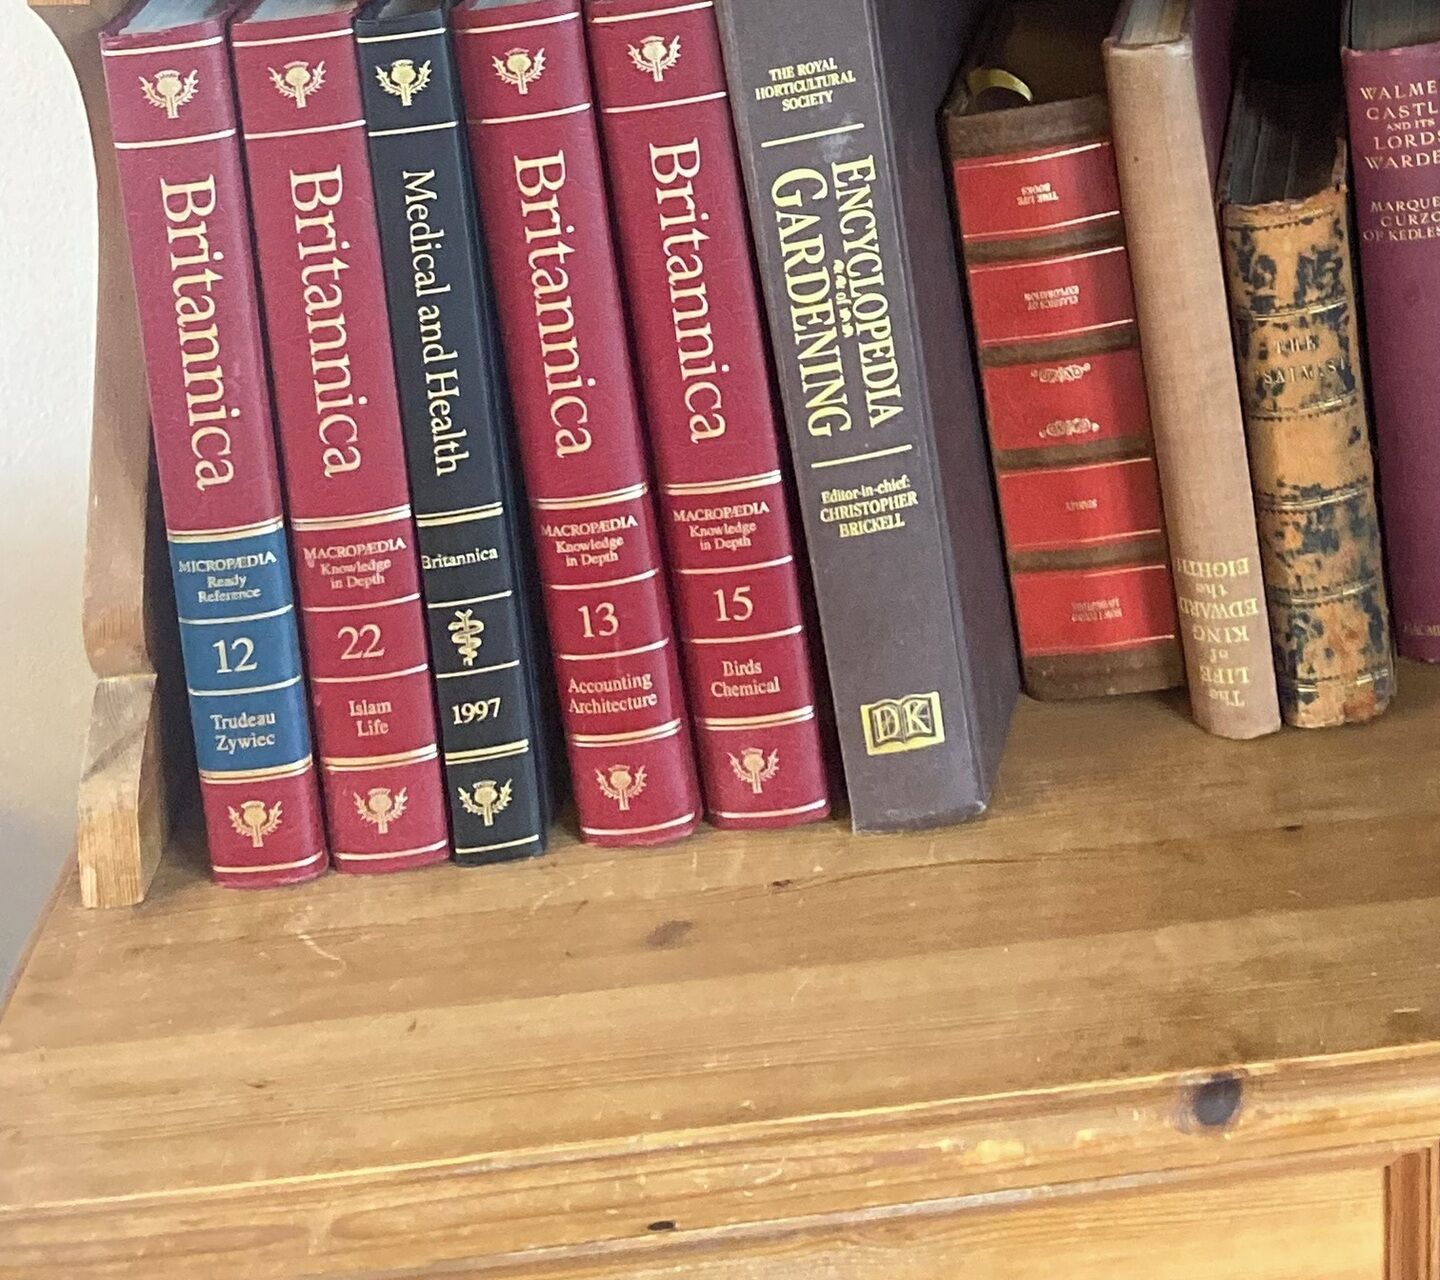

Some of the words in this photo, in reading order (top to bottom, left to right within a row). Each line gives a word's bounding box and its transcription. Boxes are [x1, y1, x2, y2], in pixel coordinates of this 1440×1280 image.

[768, 66, 795, 81] THE
[797, 57, 837, 76] ROYAL
[755, 70, 856, 100] HORTICULTURAL
[782, 90, 833, 111] SOCIETY
[1386, 121, 1411, 132] AND
[1415, 118, 1435, 129] ITS
[402, 170, 451, 298] Medical
[649, 138, 730, 444] Britannica
[831, 155, 903, 428] ENCYCLOPEDIA
[836, 291, 852, 305] of
[514, 150, 596, 458] Britannica
[771, 167, 851, 438] GARDENING
[289, 164, 367, 478] Britannica
[160, 174, 240, 492] Britannica
[418, 307, 458, 365] and
[424, 371, 470, 477] Health
[820, 491, 918, 522] CHRISTOPHER
[689, 520, 757, 538] Knowledge
[839, 513, 905, 538] BRICKELL
[556, 534, 624, 554] Knowledge
[700, 541, 711, 551] in
[715, 535, 751, 551] Depth
[320, 557, 391, 577] Knowledge
[421, 546, 499, 570] Britannica
[566, 556, 577, 567] in
[581, 551, 618, 567] Depth
[207, 573, 246, 591] Ready
[331, 577, 343, 589] in
[347, 573, 385, 590] Depth
[1195, 583, 1229, 599] the
[198, 587, 261, 603] Reference
[714, 585, 753, 622] 15
[1179, 597, 1259, 619] EDWARD
[578, 602, 619, 638] 13
[338, 624, 385, 660] 22
[1193, 625, 1250, 644] KING
[212, 637, 258, 674] 12
[1210, 649, 1228, 663] of
[722, 659, 762, 677] Birds
[1201, 666, 1250, 684] LIFE
[568, 673, 652, 695] Accounting
[711, 677, 780, 698] Chemical
[349, 698, 392, 717] Islam
[568, 693, 657, 715] Architecture
[1210, 690, 1246, 708] The
[210, 711, 275, 732] Trudeau
[452, 697, 501, 725] 1997
[357, 719, 389, 737] Life
[215, 733, 275, 755] Zywiec
